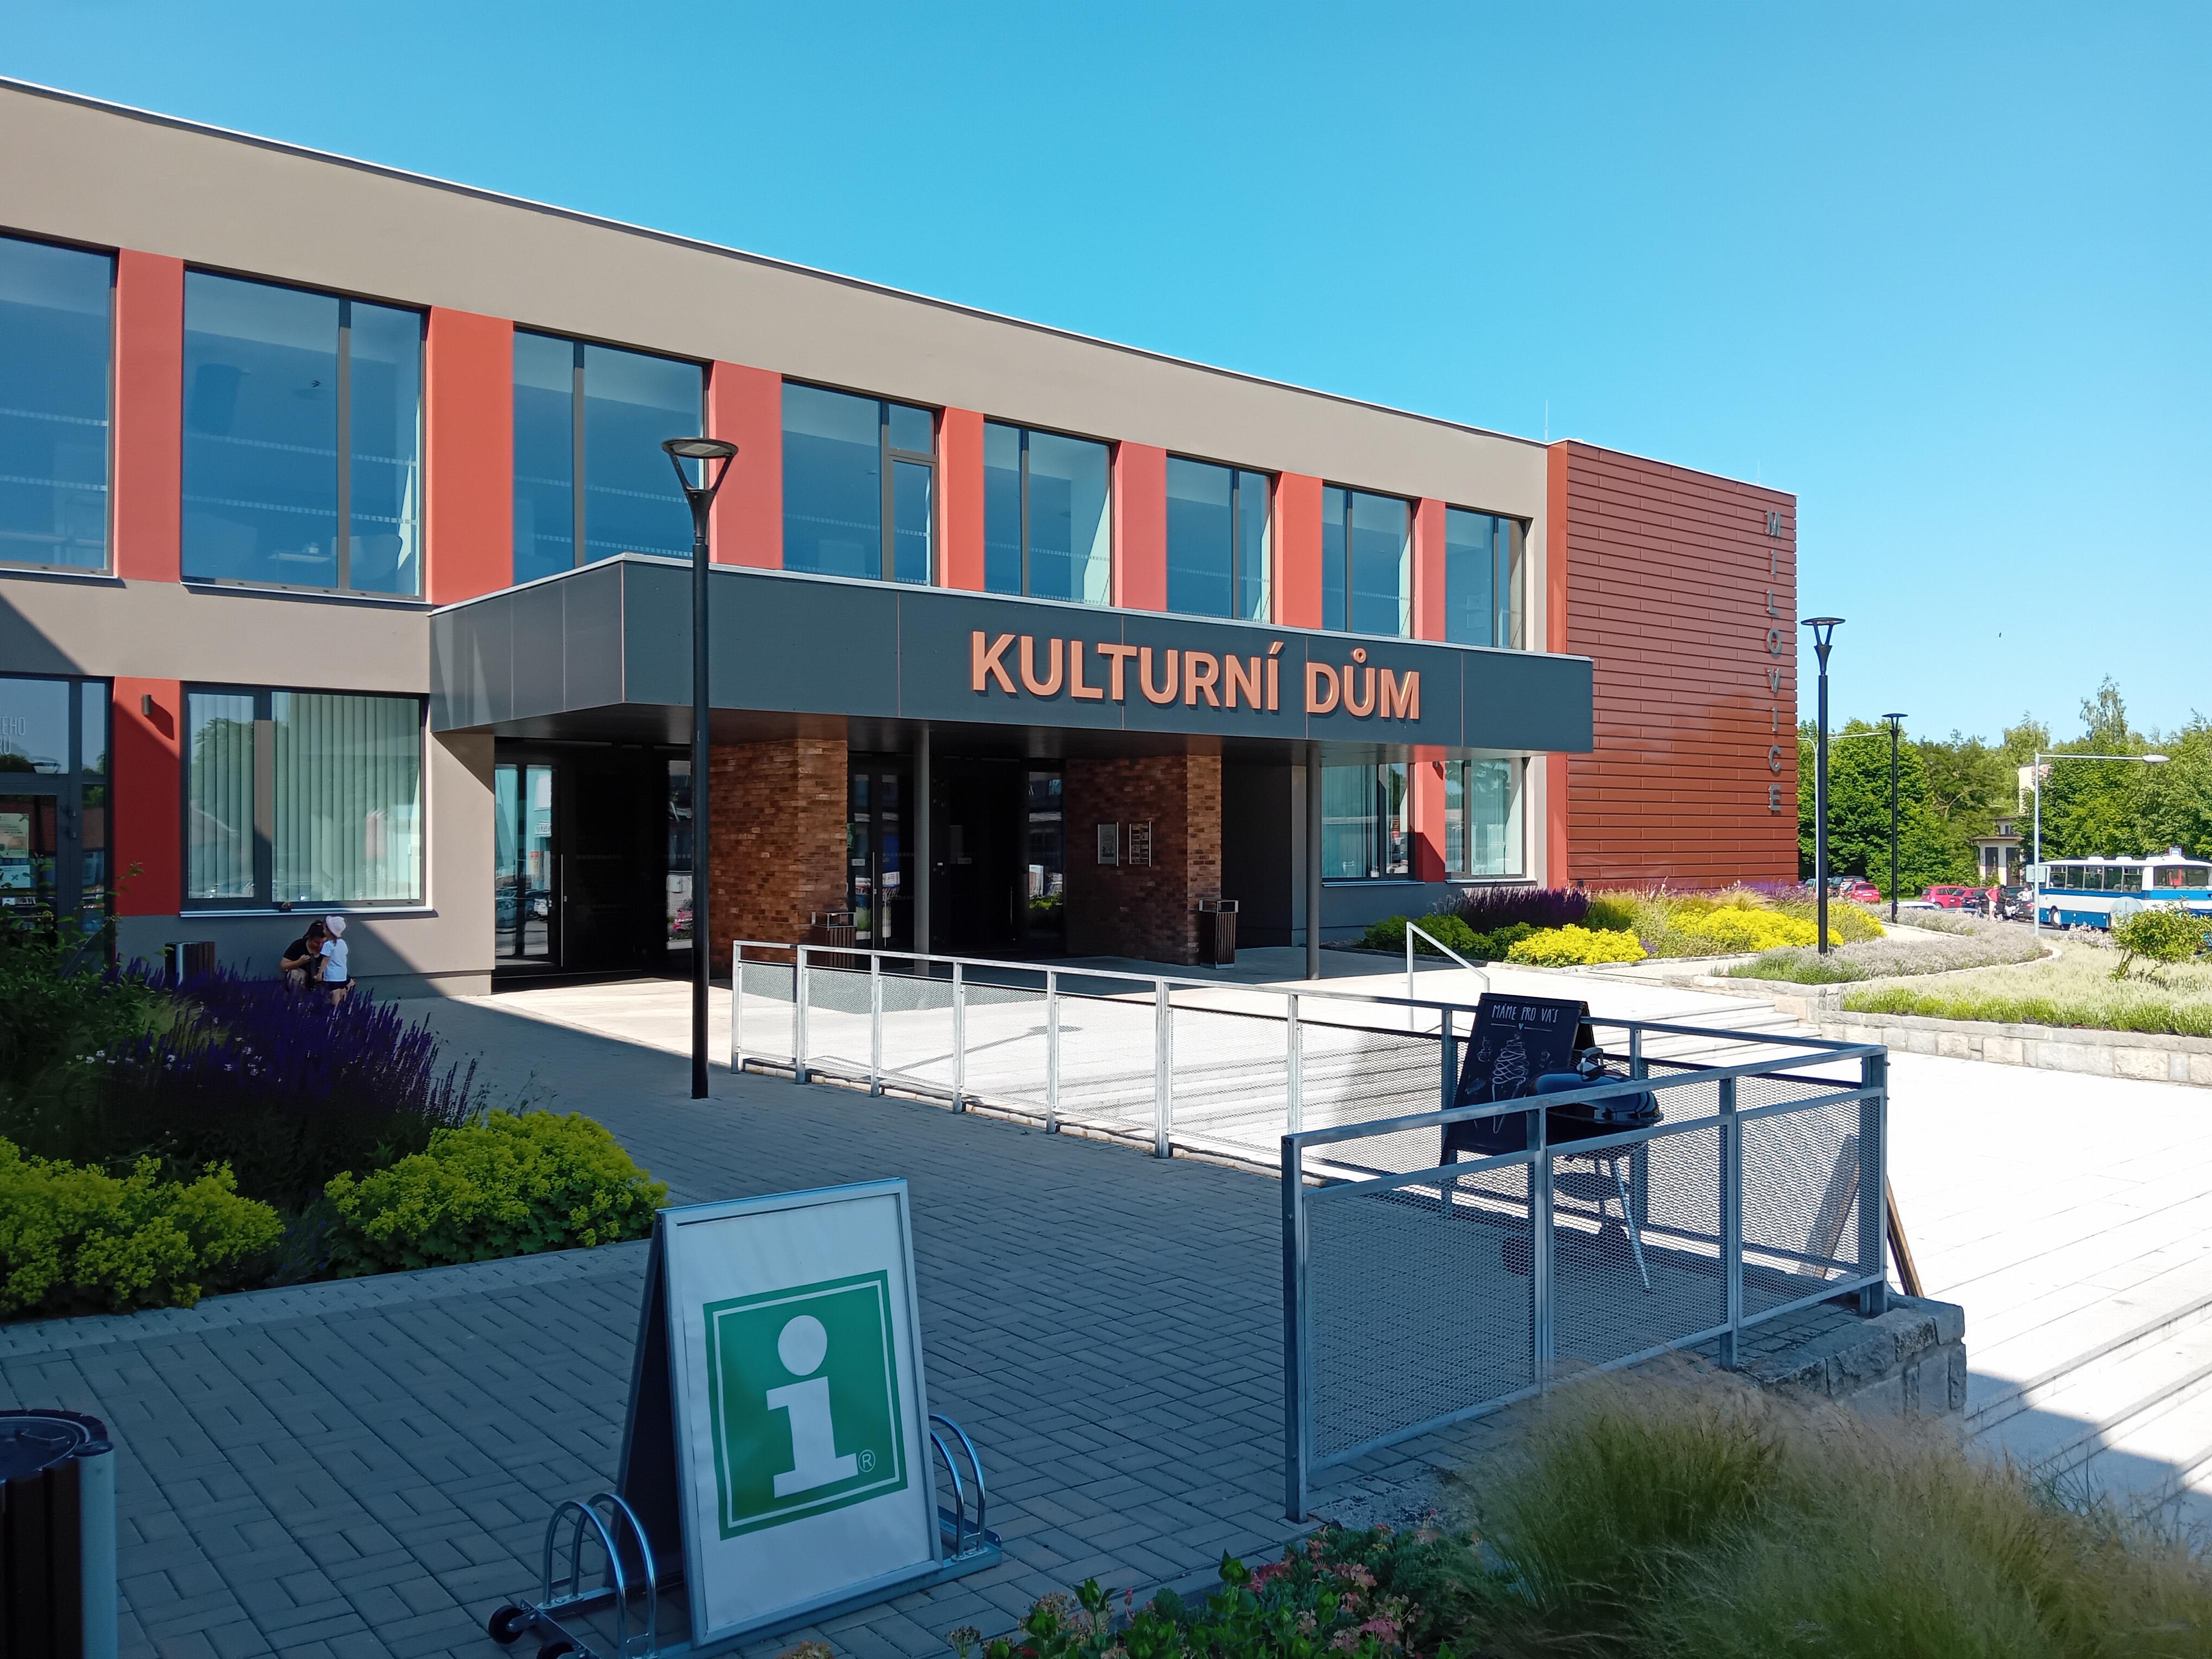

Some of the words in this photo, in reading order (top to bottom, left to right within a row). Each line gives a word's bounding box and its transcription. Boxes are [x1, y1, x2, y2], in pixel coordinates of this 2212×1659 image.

[971, 632, 1284, 711] KULTURNÍ
[1306, 648, 1421, 720] DŮM
[1765, 509, 1781, 811] MILOVICE
[1491, 1003, 1517, 1020] MÁME
[1521, 1006, 1537, 1021] PRO
